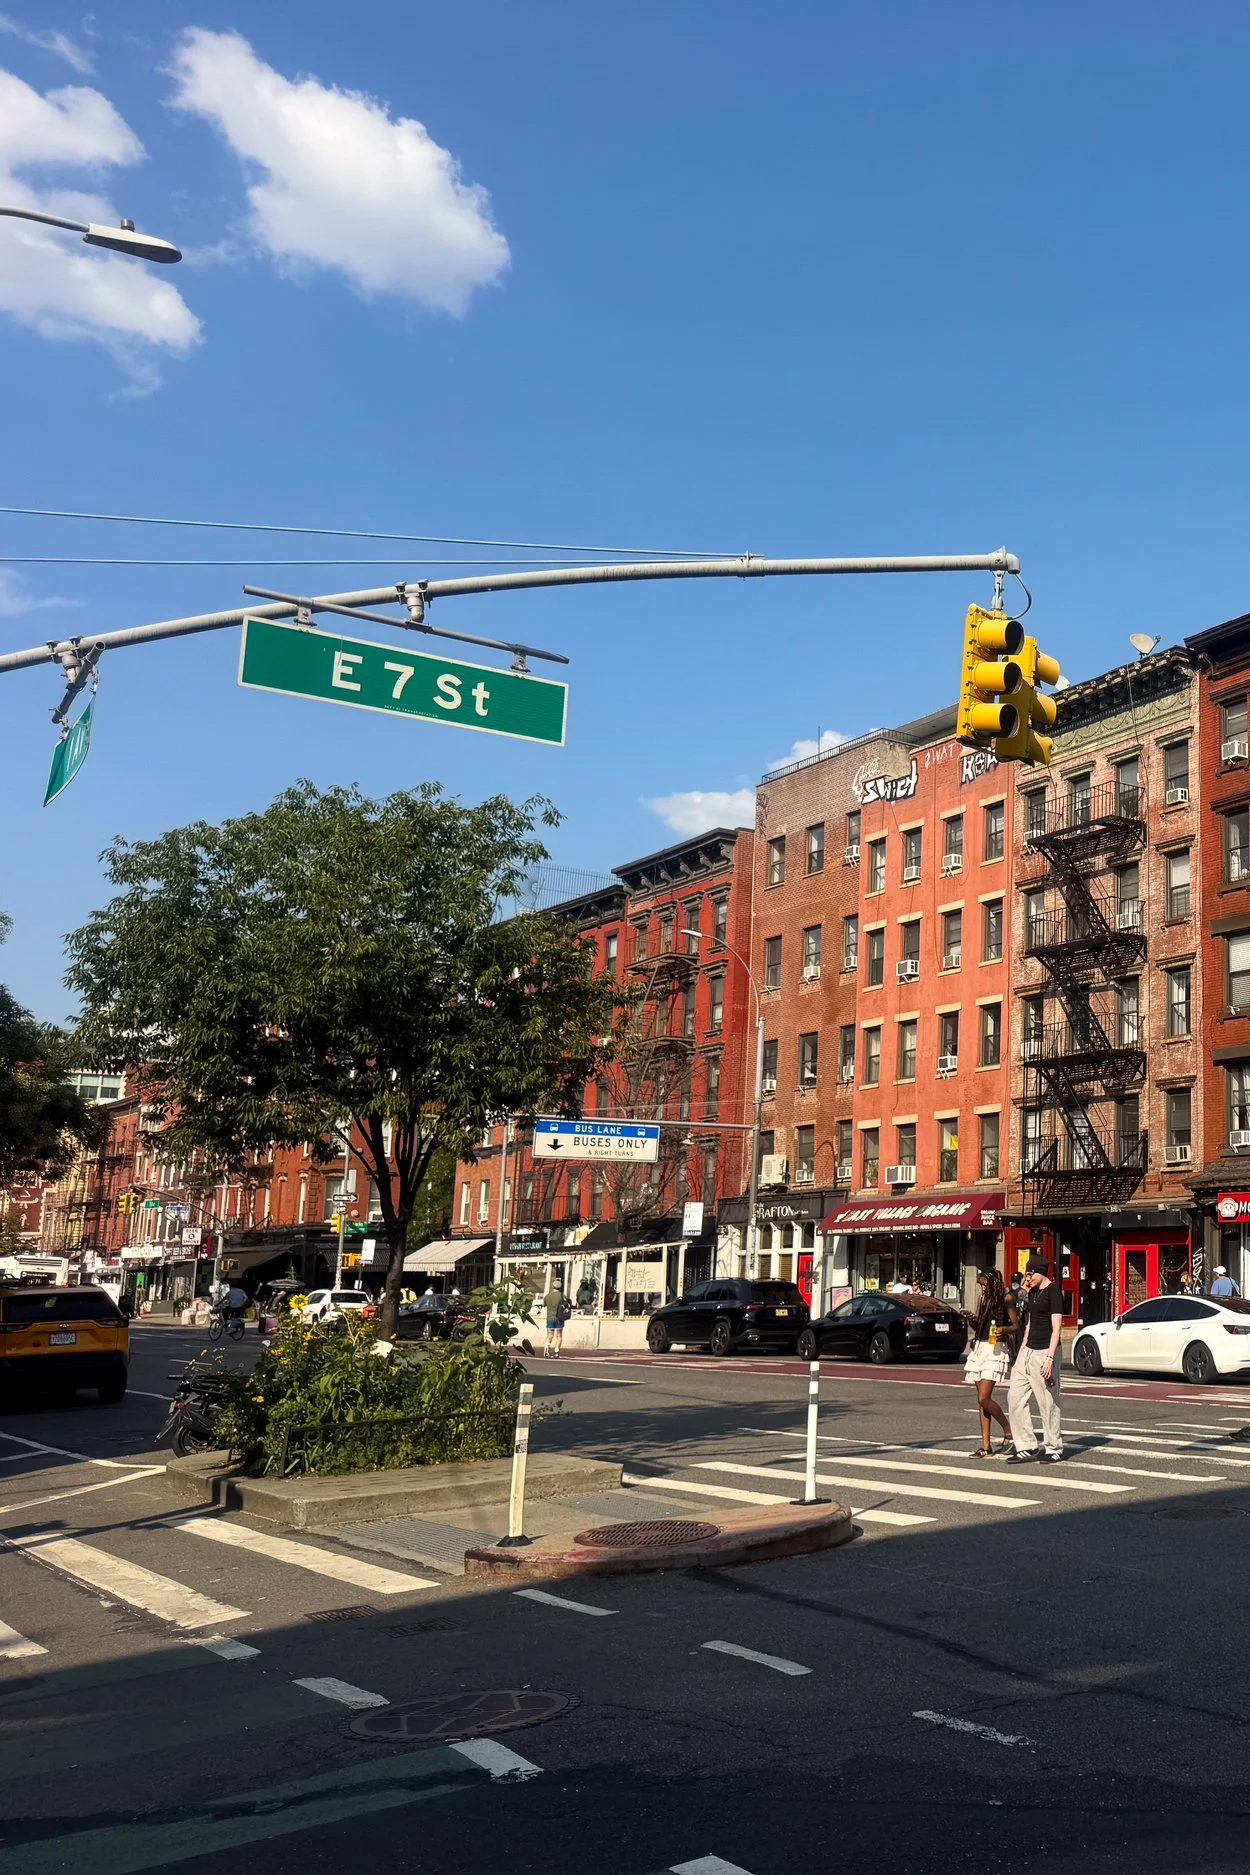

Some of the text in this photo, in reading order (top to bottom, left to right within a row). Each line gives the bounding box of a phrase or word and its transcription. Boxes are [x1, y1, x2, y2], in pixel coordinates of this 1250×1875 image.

[332, 651, 490, 717] E 7 St
[575, 1124, 622, 1135] BUS LANE
[573, 1136, 648, 1149] BUSES ONLY
[841, 1202, 971, 1222] EAST VILLAGE ORGANIC
